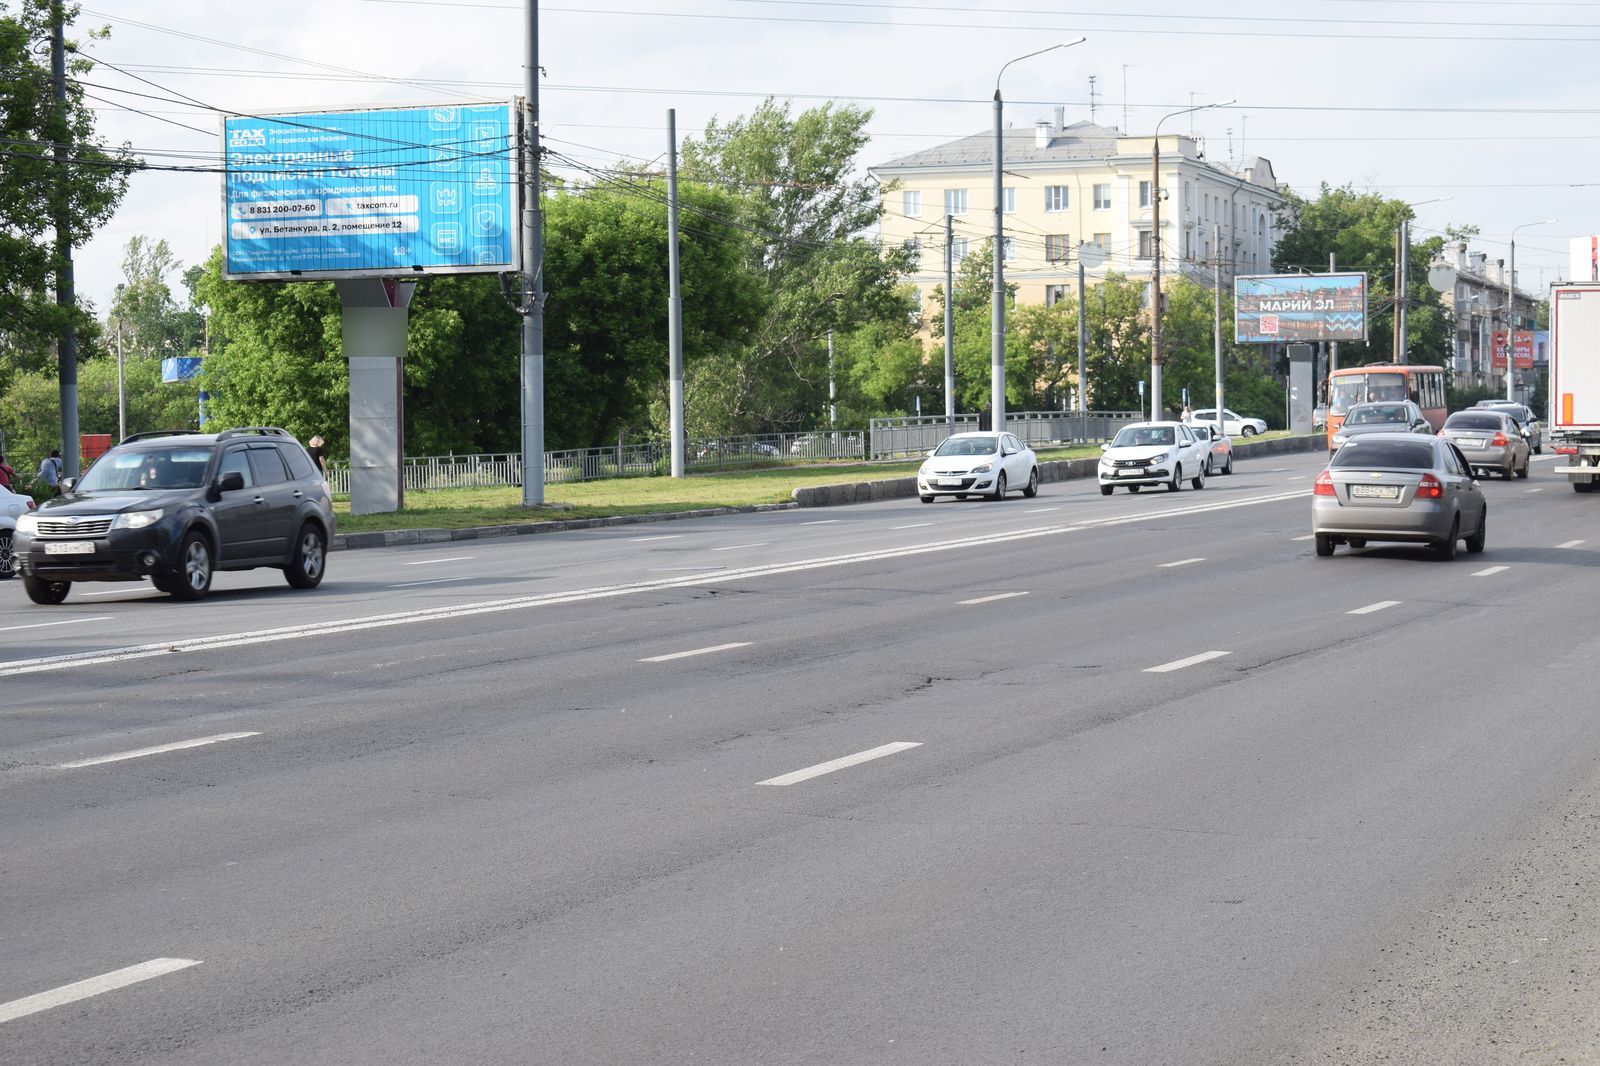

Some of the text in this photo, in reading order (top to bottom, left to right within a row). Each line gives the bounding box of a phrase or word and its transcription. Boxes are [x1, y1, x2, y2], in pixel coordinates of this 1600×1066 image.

[229, 128, 265, 139] TAX
[229, 149, 354, 167] Электронные
[231, 163, 396, 184] подписи и токены
[231, 185, 397, 199] Для физических и юридических лиц
[249, 204, 316, 214] 8 831 200-07-60
[260, 227, 272, 235] ул.
[274, 225, 320, 234] Бетанкура,
[341, 222, 390, 231] помещение
[391, 221, 402, 229] 12
[1259, 297, 1335, 311] МАРИЙ ЭЛ
